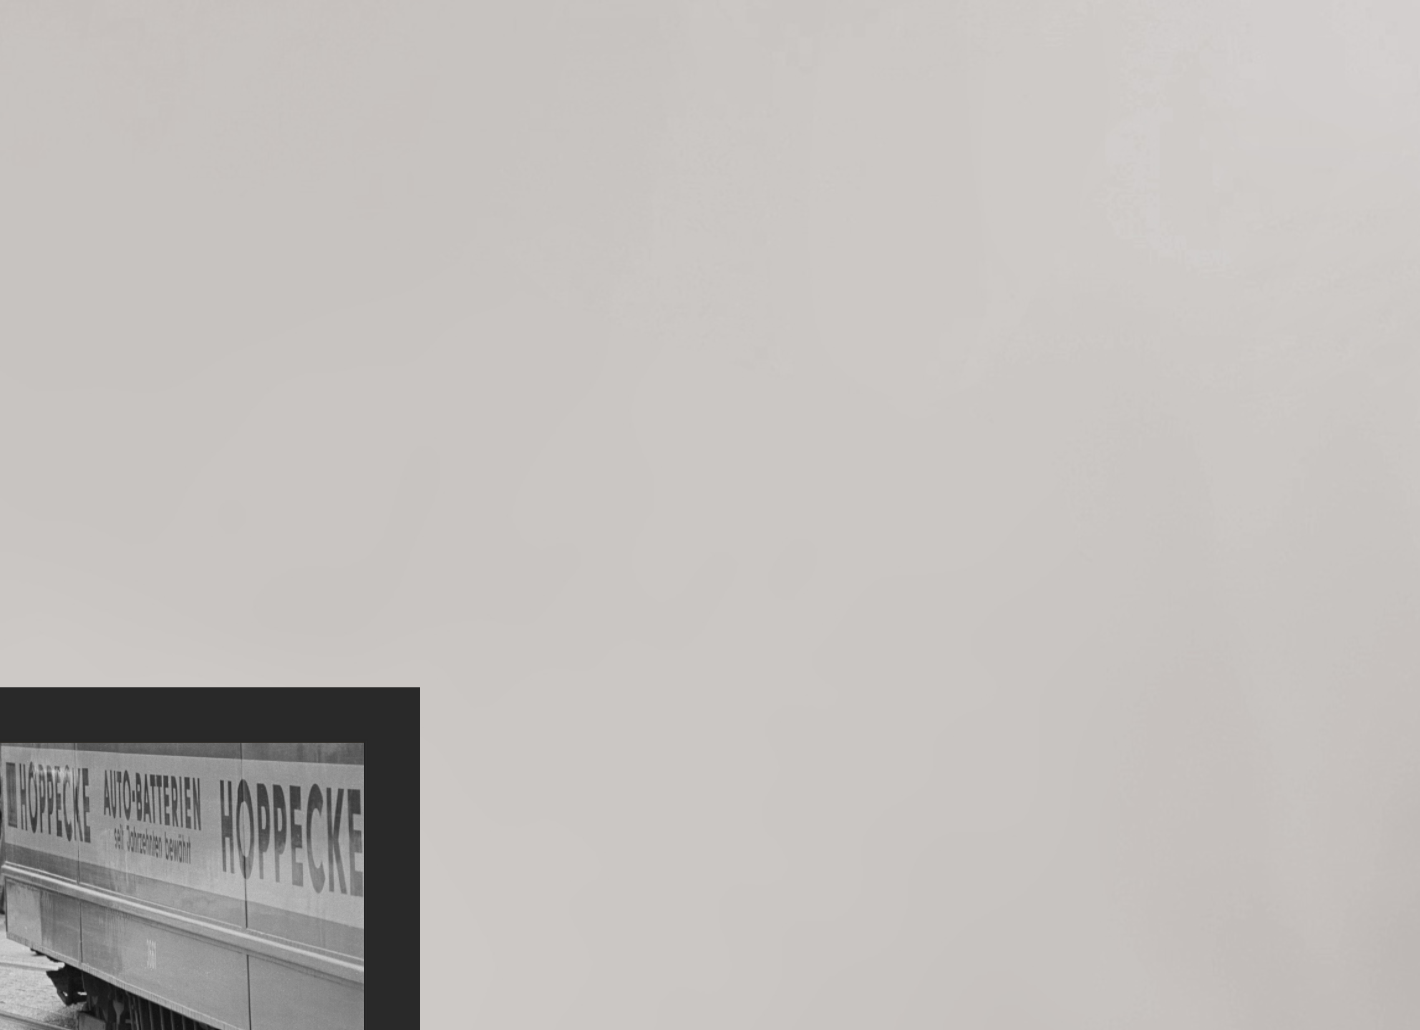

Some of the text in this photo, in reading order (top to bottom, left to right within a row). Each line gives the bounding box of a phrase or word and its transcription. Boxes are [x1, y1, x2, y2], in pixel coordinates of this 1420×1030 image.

[19, 761, 91, 843] HOPPECKE
[103, 769, 202, 831] AUTO-BATTERIEN
[219, 778, 364, 897] HOPPECKE
